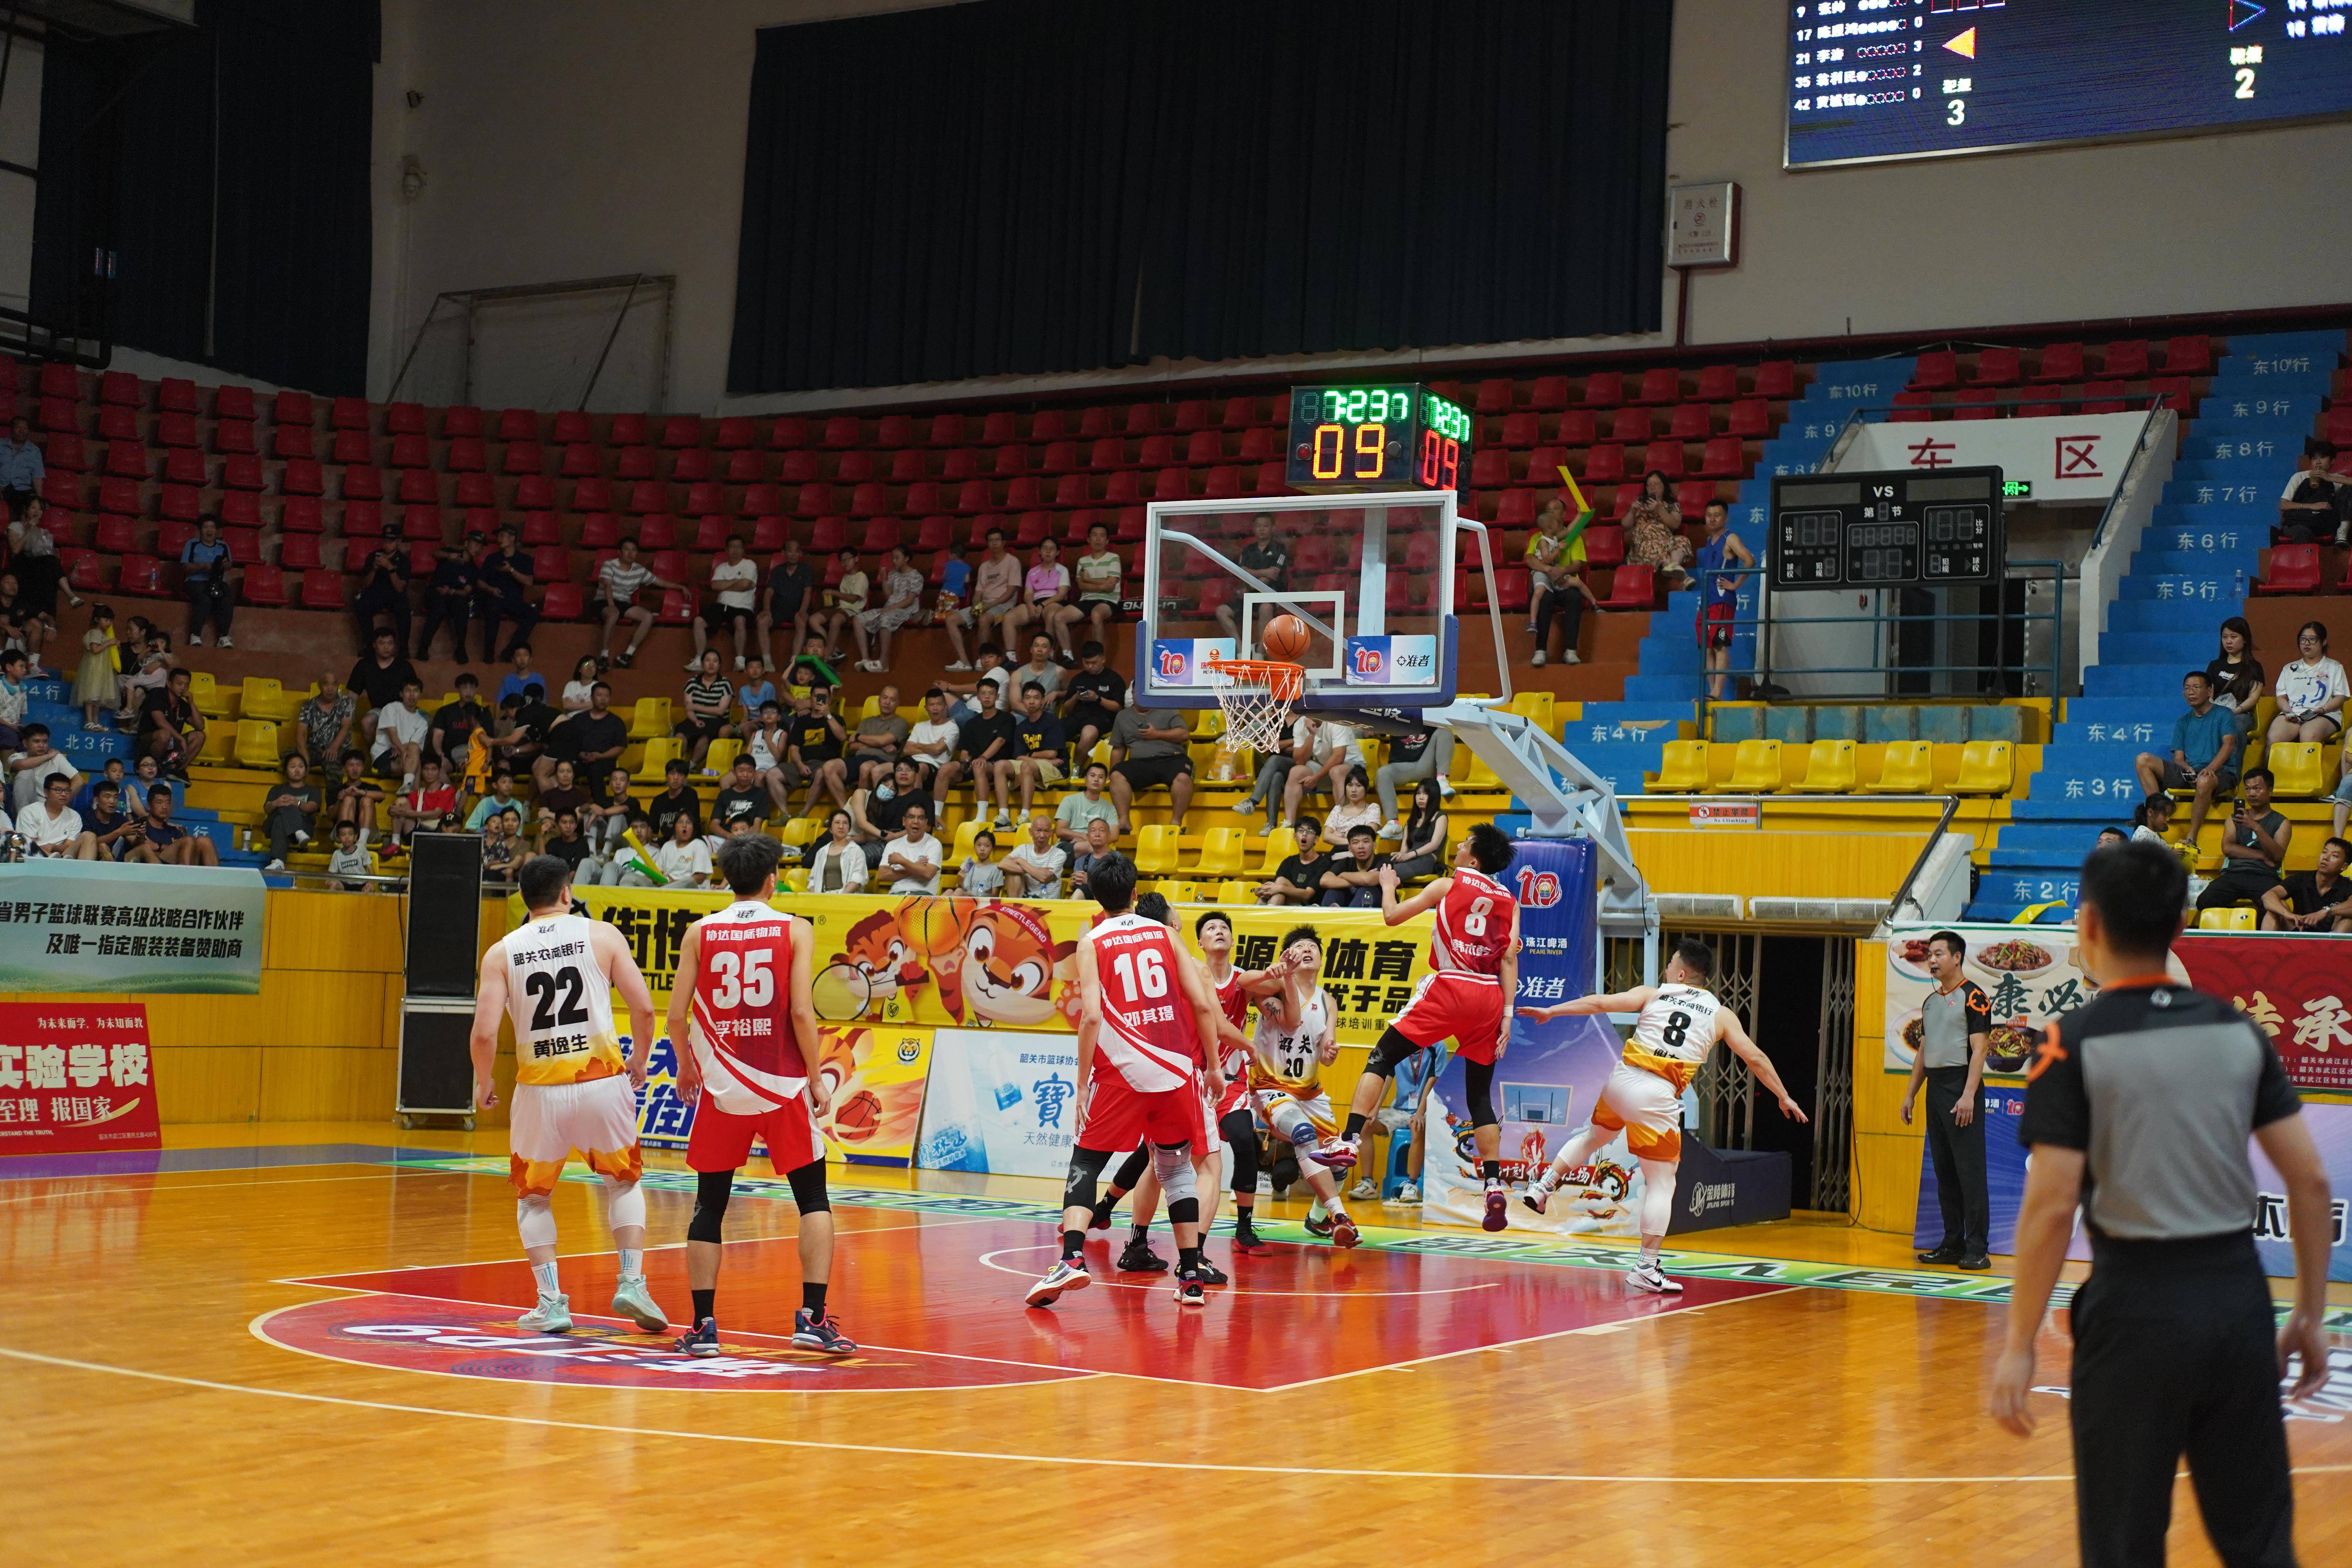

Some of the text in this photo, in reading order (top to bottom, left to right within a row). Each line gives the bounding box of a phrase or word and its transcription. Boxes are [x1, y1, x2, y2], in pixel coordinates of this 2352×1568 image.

[1797, 7, 1806, 17] 9
[1797, 29, 1812, 40] 17
[1914, 16, 1922, 27] 0
[1796, 53, 1810, 64] 21
[1914, 41, 1922, 51] 3
[1795, 77, 1810, 87] 35
[1913, 65, 1921, 76] 2
[2235, 68, 2254, 99] 2
[1794, 99, 1810, 111] 42
[1913, 88, 1920, 98] 0
[1947, 99, 1965, 125] 3
[2253, 356, 2310, 376] 东10行
[1829, 383, 1878, 399] 东10行
[2232, 400, 2290, 417] 东9行
[1804, 423, 1836, 439] 东9
[1313, 424, 1385, 478] 09
[1423, 430, 1458, 490] 09
[2056, 435, 2103, 479] 区
[2215, 440, 2275, 460] 东8行
[1873, 486, 1894, 498] VS
[2197, 485, 2257, 504] 东7行
[1864, 506, 1902, 519] 第 节
[2177, 531, 2239, 551] 东6行
[2156, 580, 2219, 601] 东5行
[1405, 655, 1430, 666] 准者
[65, 735, 114, 751] 北3行
[1591, 725, 1648, 742] 东4行
[2087, 722, 2153, 743] 东4行
[1560, 775, 1617, 794] 东行
[2065, 778, 2134, 800] 东3行
[2011, 880, 2080, 902] 东2行
[0, 902, 244, 931] 省男子篮球联赛高级战略合作伙伴
[1000, 906, 1047, 943] STREETLEGEND
[1465, 897, 1494, 936] 8
[706, 927, 782, 941] 协达国际物流
[1102, 931, 1164, 949] 协达国际物流
[1526, 937, 1567, 949] 珠江啤酒
[46, 933, 243, 958] 及唯一指定服装装备赞助商
[513, 941, 585, 966] 韶关农商银行
[711, 949, 774, 1009] 35
[1114, 949, 1167, 1002] 16
[1522, 976, 1566, 998] 准者
[526, 966, 588, 1031] 22
[1659, 995, 1713, 1015] 韶关农商银行
[1123, 1005, 1174, 1028] 邓其璟
[715, 1018, 771, 1038] 李裕熙
[1663, 1011, 1691, 1047] 8
[534, 1034, 589, 1058] 黄逸生
[0, 1044, 148, 1089] 实验学校
[1283, 1058, 1303, 1078] 20
[50, 1096, 113, 1122] 报国家
[1033, 1072, 1075, 1129] 寶
